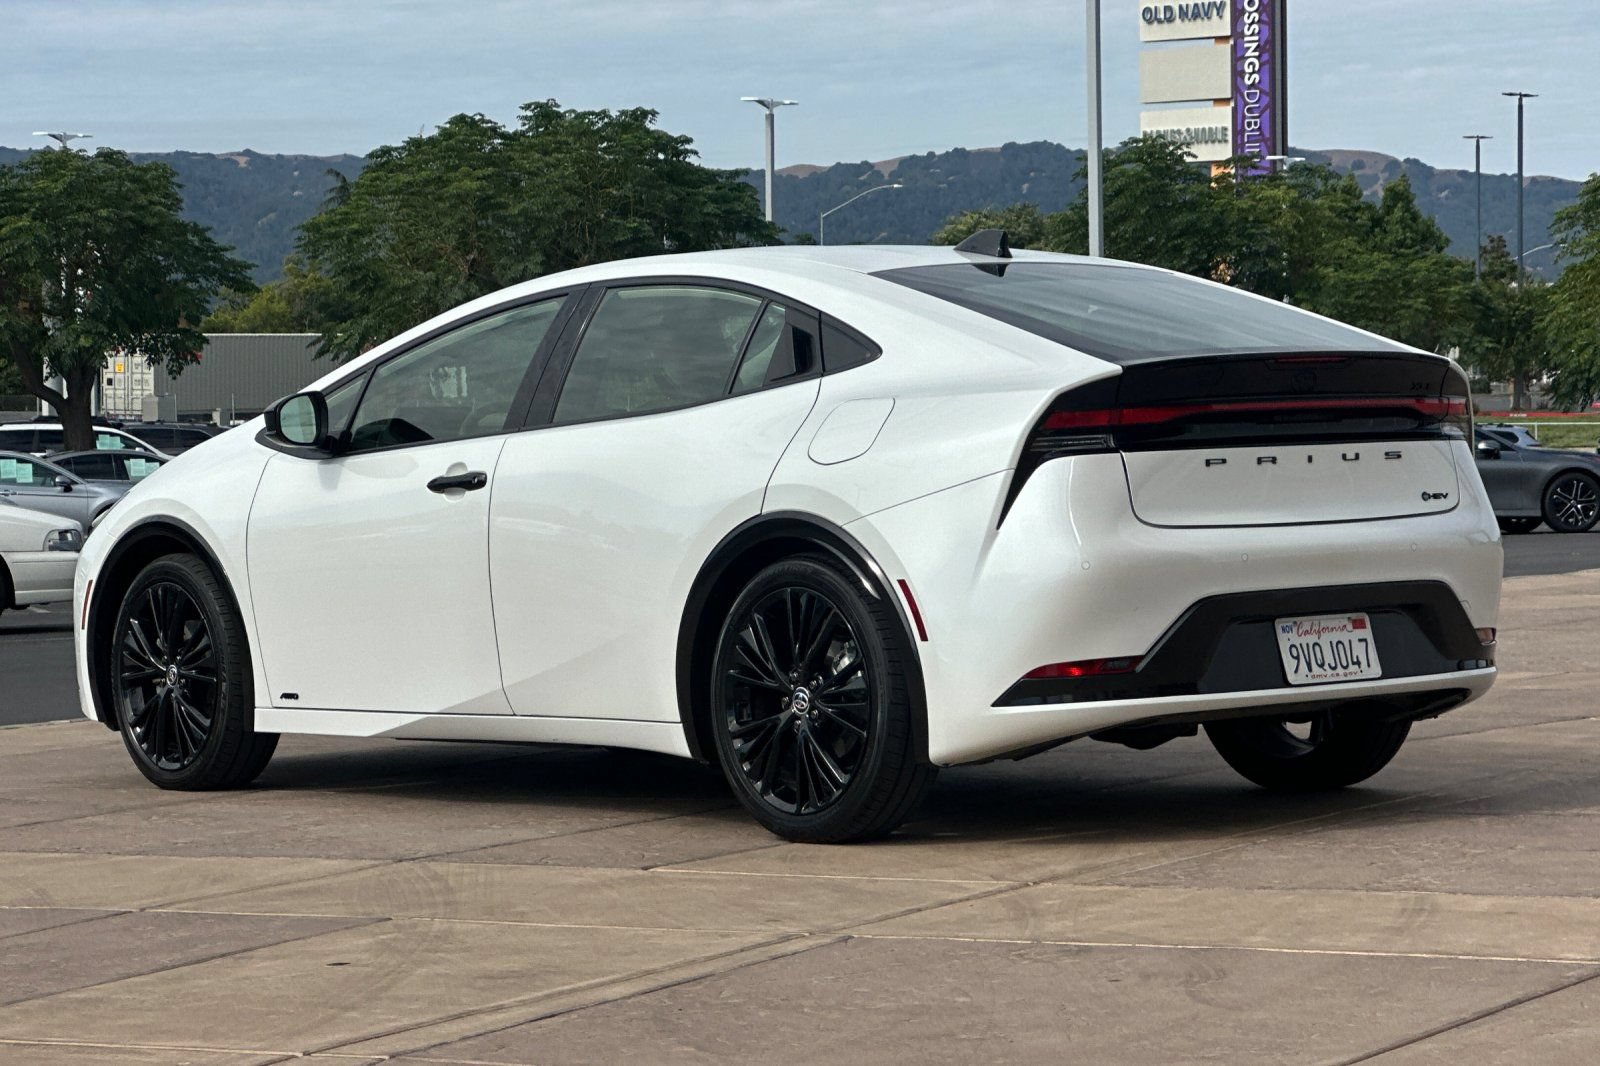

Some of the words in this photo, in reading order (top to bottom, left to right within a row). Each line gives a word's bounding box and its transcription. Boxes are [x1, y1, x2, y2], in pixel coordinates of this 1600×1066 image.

[1142, 5, 1175, 24] OLD
[1178, 1, 1226, 22] NAVY
[1205, 450, 1402, 467] PRIUS
[1296, 620, 1348, 640] California
[1289, 638, 1371, 674] 9VQJ047
